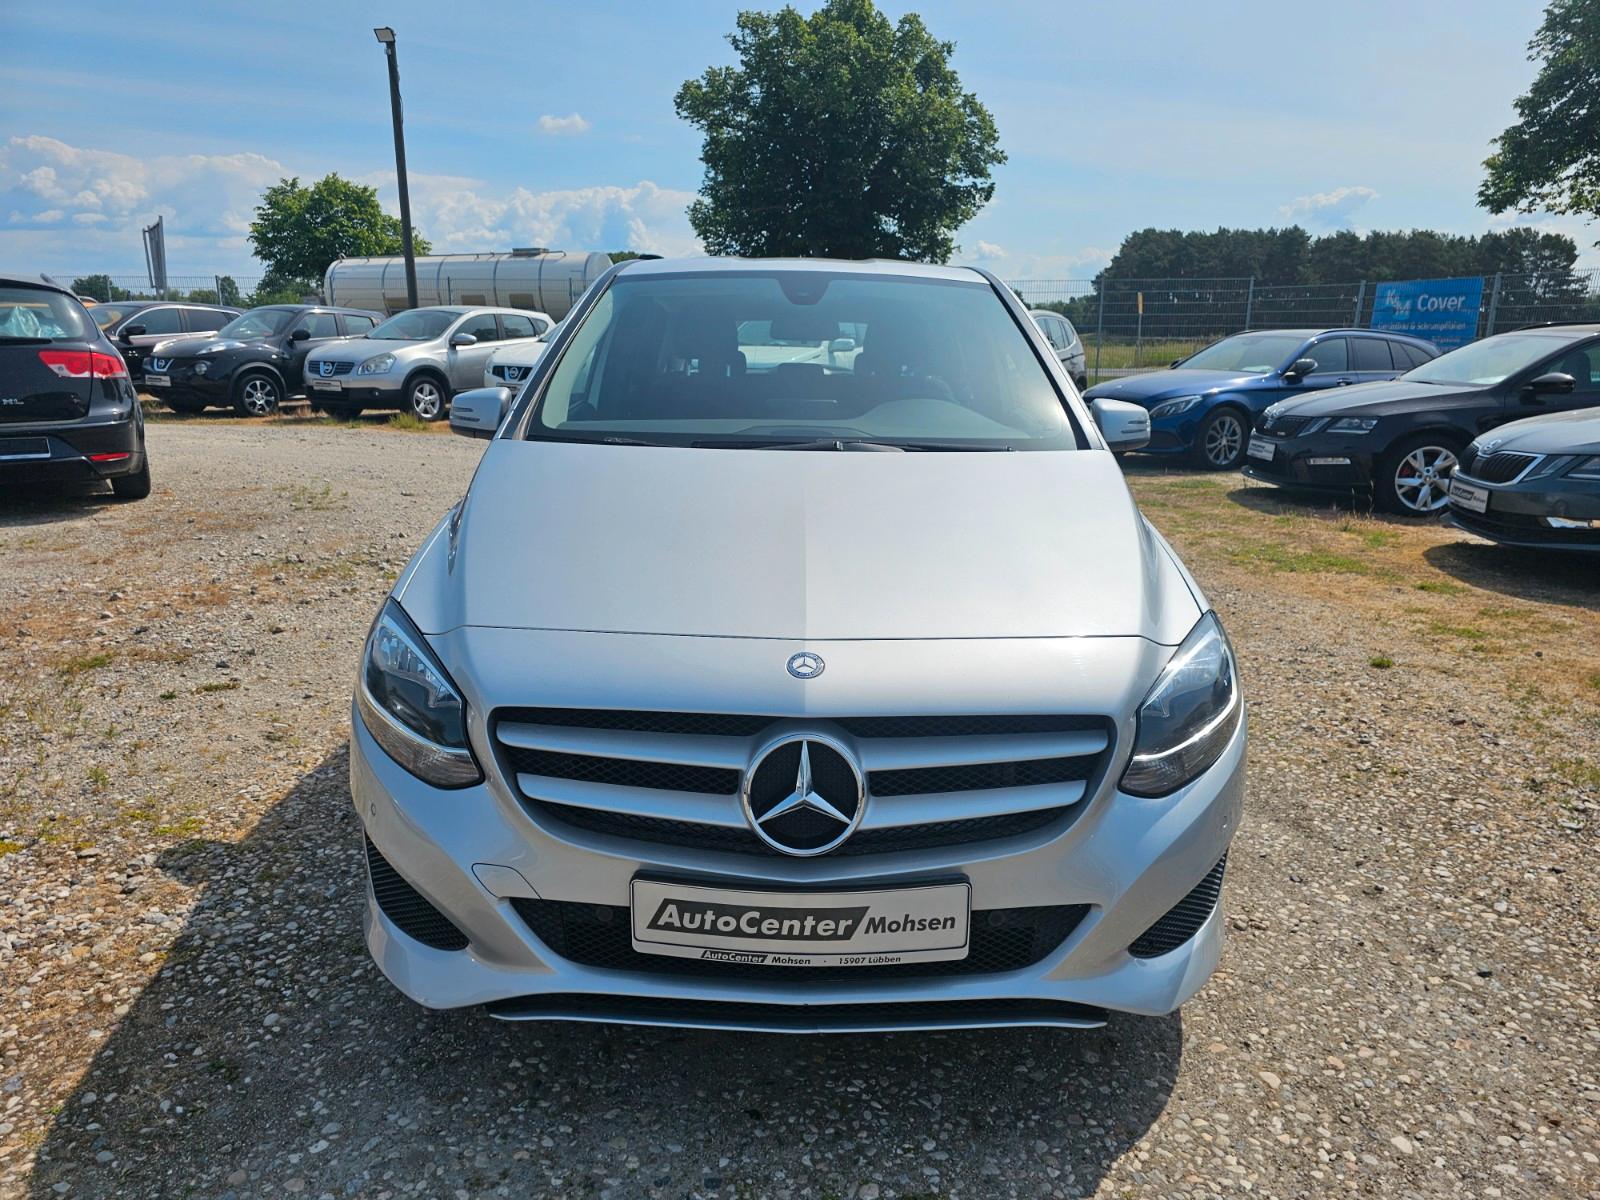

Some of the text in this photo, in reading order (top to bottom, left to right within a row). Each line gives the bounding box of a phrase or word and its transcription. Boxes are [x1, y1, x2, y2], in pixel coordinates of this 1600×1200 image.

[1417, 294, 1466, 312] Cover
[657, 904, 956, 936] AutoCenter Mohsen
[703, 950, 901, 965] AutoCenter Mohsen 15907 Lübben
